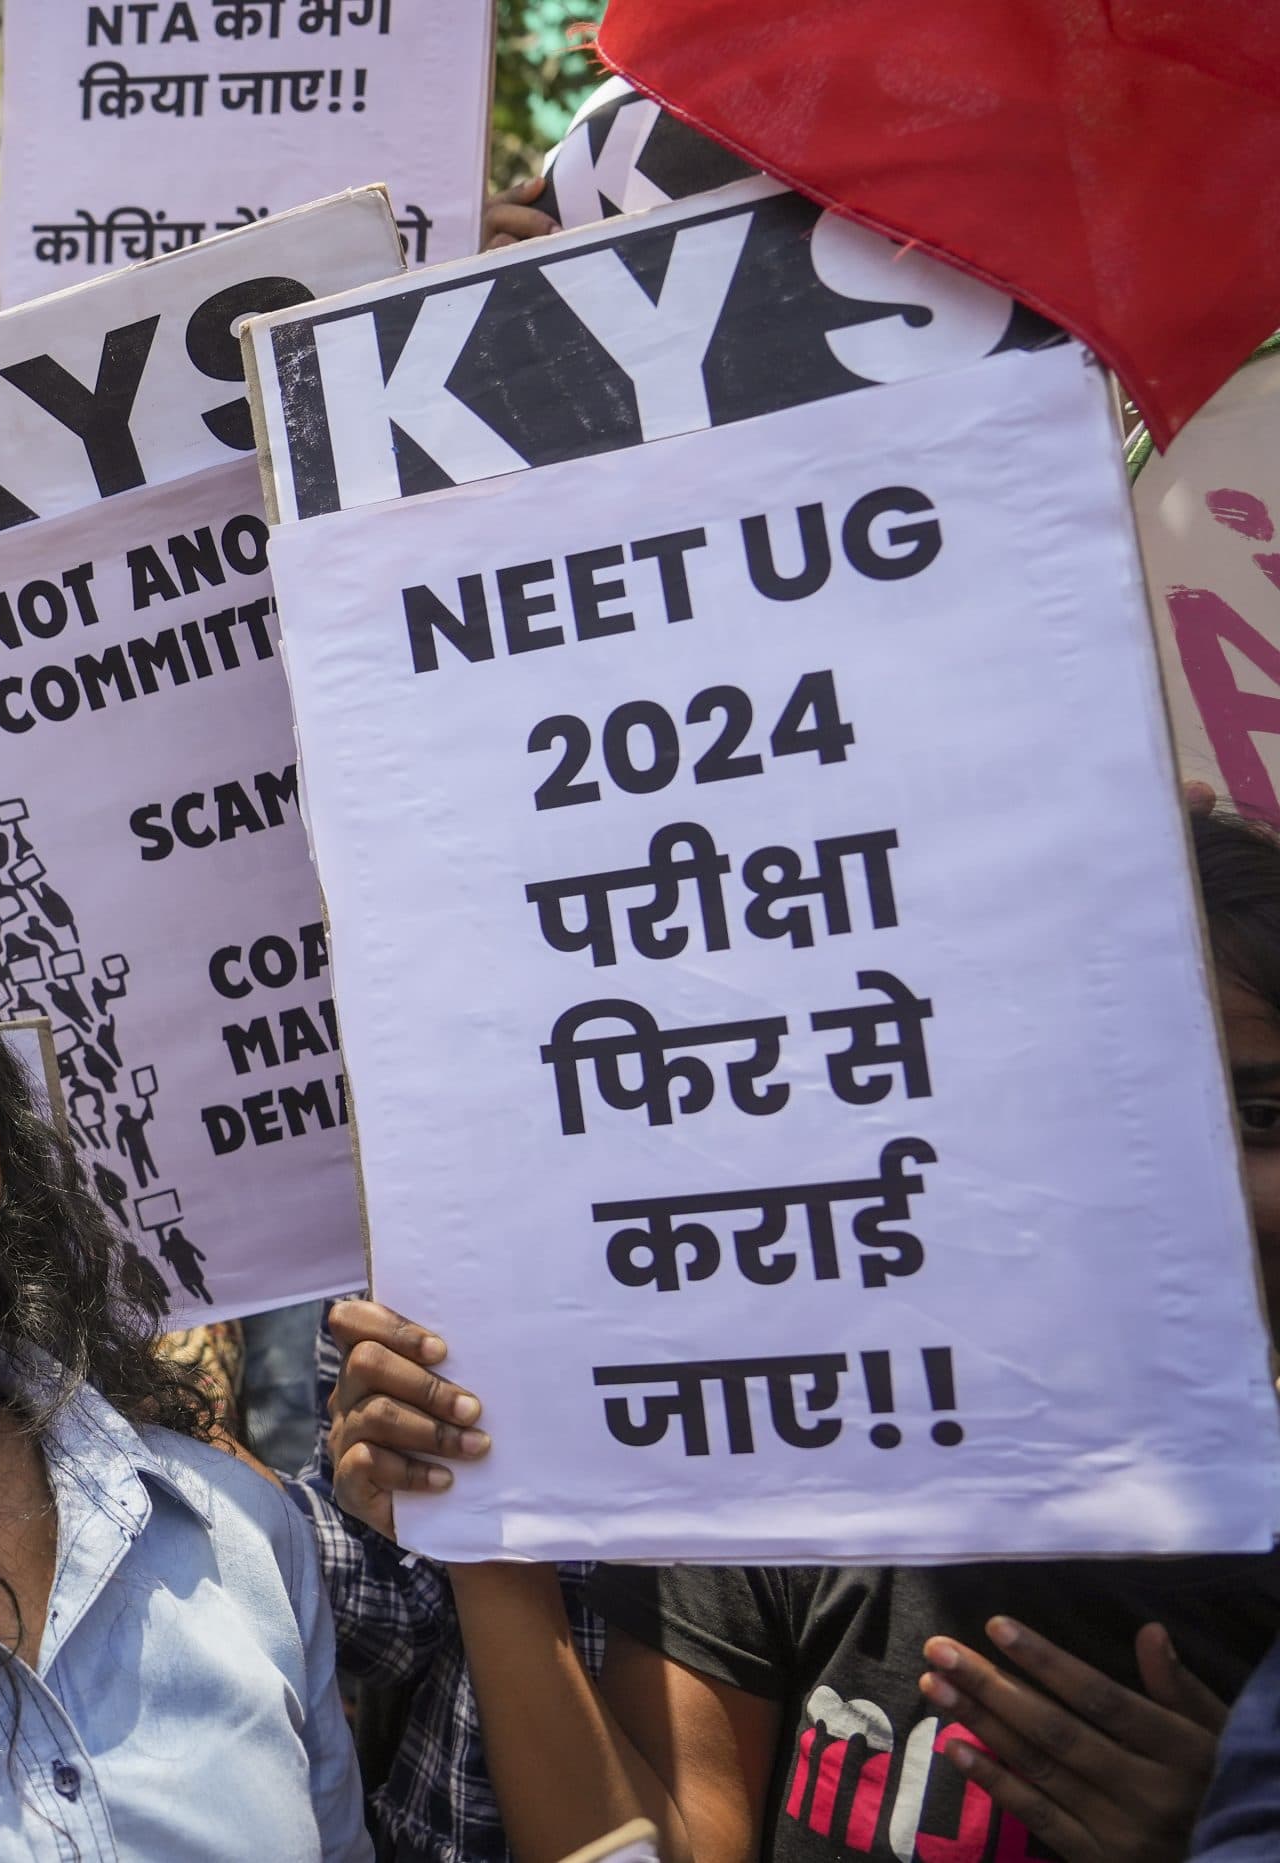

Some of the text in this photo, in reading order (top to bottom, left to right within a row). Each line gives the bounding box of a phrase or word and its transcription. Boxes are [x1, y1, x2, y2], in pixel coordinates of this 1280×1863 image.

[79, 61, 368, 120] किया जाए!!
[87, 2, 199, 46] NTA
[402, 486, 943, 674] NEET UG
[526, 669, 856, 811] 2024
[129, 764, 300, 861] SCAM
[525, 822, 899, 968] परीक्षा
[540, 970, 933, 1136] फिर से
[592, 1137, 938, 1292] कराई
[592, 1346, 964, 1456] जाए!!
